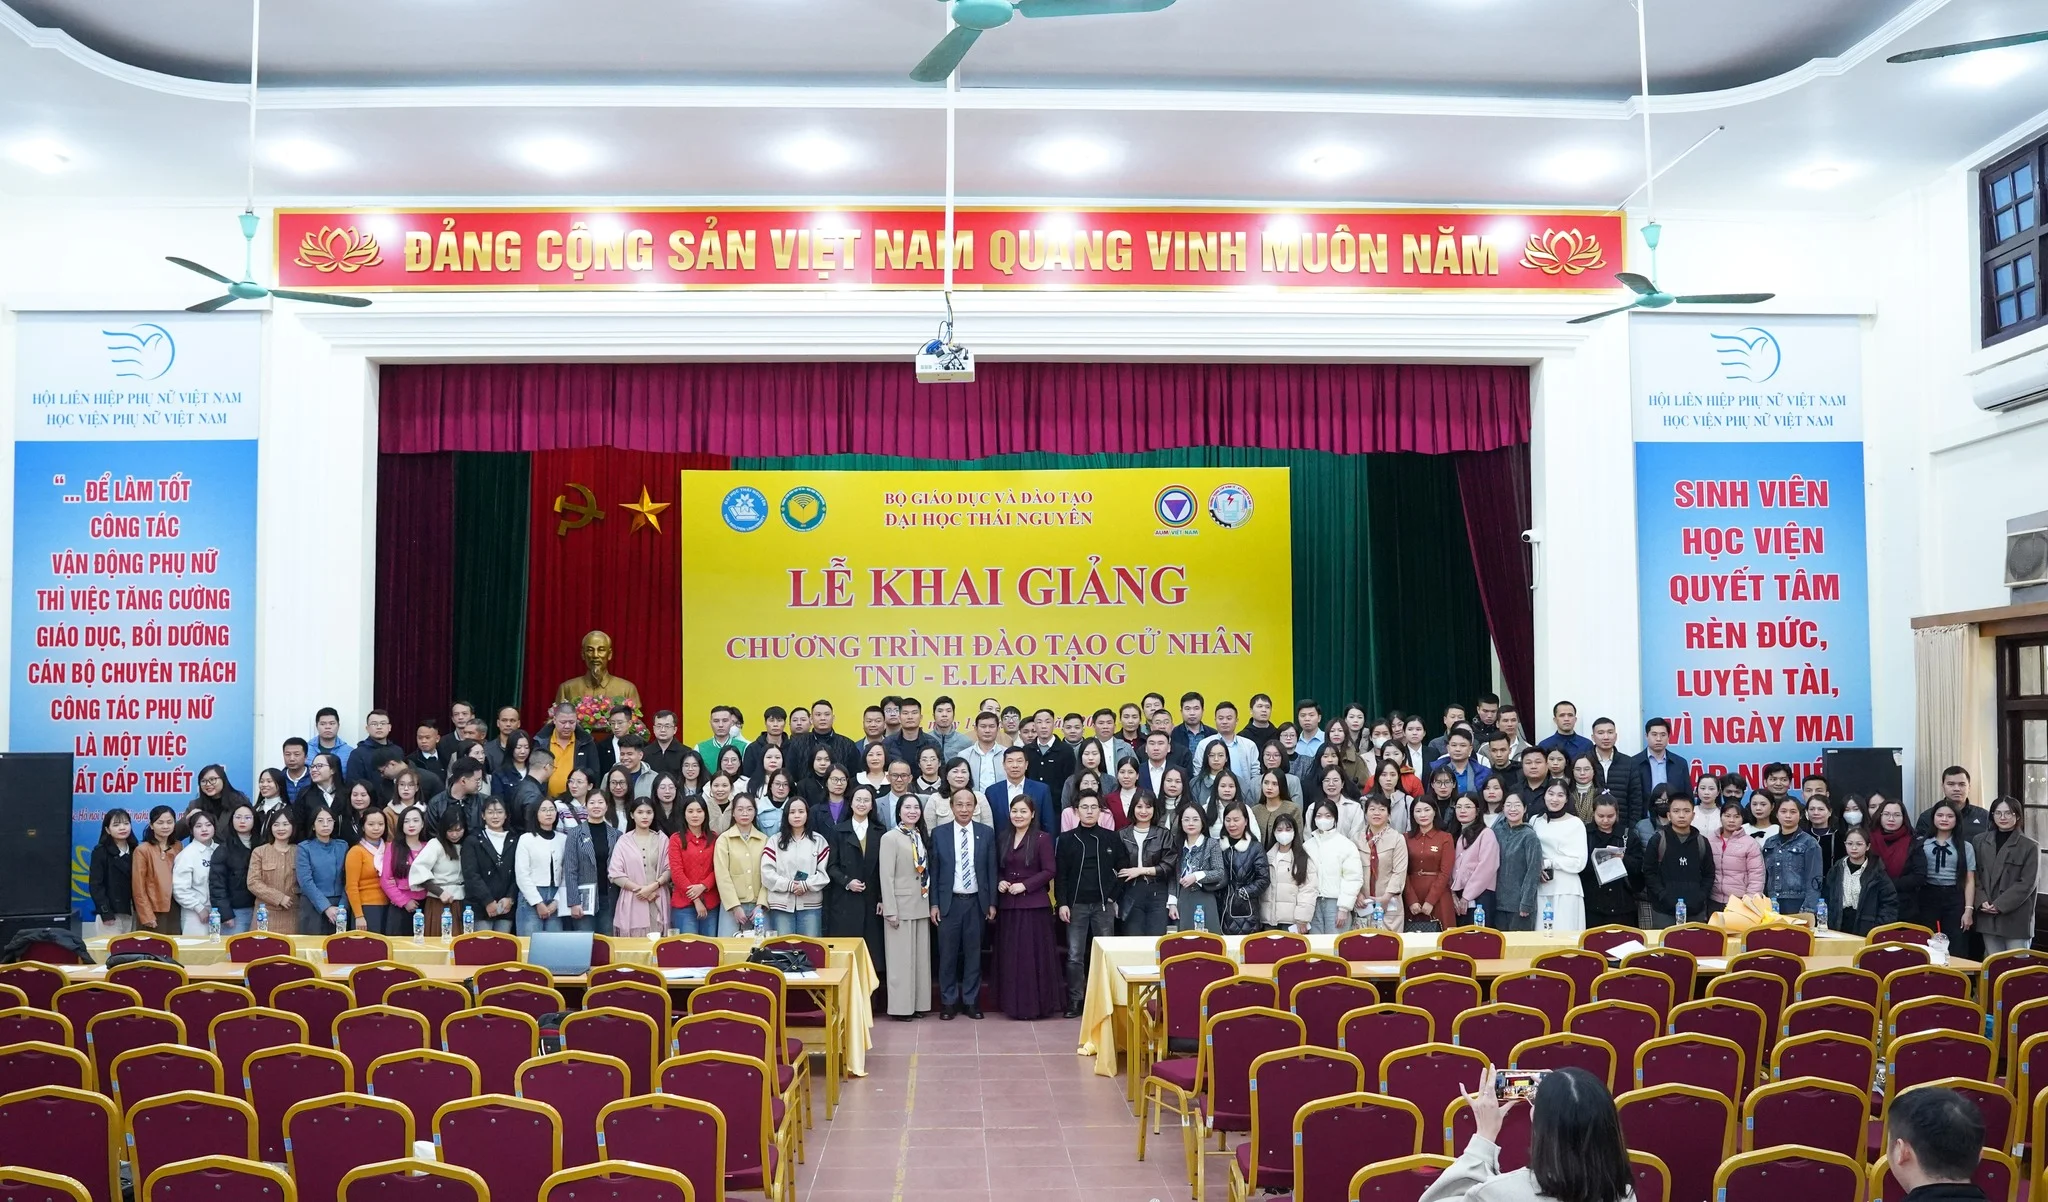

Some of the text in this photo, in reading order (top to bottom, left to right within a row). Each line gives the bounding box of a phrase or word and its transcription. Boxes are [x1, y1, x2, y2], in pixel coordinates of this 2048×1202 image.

[403, 217, 522, 272] ĐẢNG
[536, 221, 653, 280] CỘNG
[667, 215, 756, 271] SẢN
[874, 229, 974, 270] NAM
[989, 229, 1133, 275] QUANG
[1146, 230, 1247, 272] VINH
[1261, 224, 1388, 274] MUÔN
[1402, 225, 1499, 275] NĂM
[32, 389, 242, 408] HỘI LIÊN HIỆP PHỤ NỮ VIỆT NAM
[1648, 391, 1846, 409] HỘI LIÊN HIỆP PHỤ NỮ VIỆT NAM
[46, 409, 227, 428] HỌC VIỆN PHỤ NỮ VIỆT NAM
[1663, 411, 1834, 429] HỌC VIỆN PHỤ NỮ VIỆT NAM
[86, 472, 111, 502] ĐỂ
[114, 473, 153, 502] LÀM
[159, 472, 191, 501] TỐT
[885, 489, 1093, 507] BỘ GIÁO DỤC VÀ ĐÀO TẠO
[1674, 474, 1829, 508] SINH VIÊN
[90, 512, 180, 538] CÔNG TÁC
[885, 508, 1093, 529] ĐẠI HỌC THÁI NGUYÊN
[1682, 522, 1824, 561] HỌC VIỆN
[52, 549, 219, 579] VẬN ĐỘNG PHỤ NỮ
[787, 555, 1188, 608] LỄ KHAI GIẢNG
[1669, 566, 1840, 605] QUYẾT TÂM
[37, 585, 230, 615] THÌ VIỆC TĂNG CƯỜNG
[37, 619, 229, 651] GIÁO DỤC, BỒI DƯỠNG
[726, 625, 1252, 662] CHƯƠNG TRÌNH ĐÀO TẠO CỬ NHÂN
[1685, 615, 1828, 651] RÈN ĐỨC,
[28, 657, 237, 688] CÁN BỘ CHUYÊN TRÁCH
[855, 665, 917, 688] TNU
[942, 663, 1127, 686] E.LEARNING
[1677, 662, 1839, 702] LUYỆN TÀI,
[51, 694, 215, 724] CÔNG TÁC PHỤ NỮ
[1703, 710, 1786, 744] NGÀY
[1796, 714, 1855, 743] MAI
[75, 731, 187, 760] LÀ MỘT VIỆC
[73, 765, 193, 793] ẤT CẤP THIẾT
